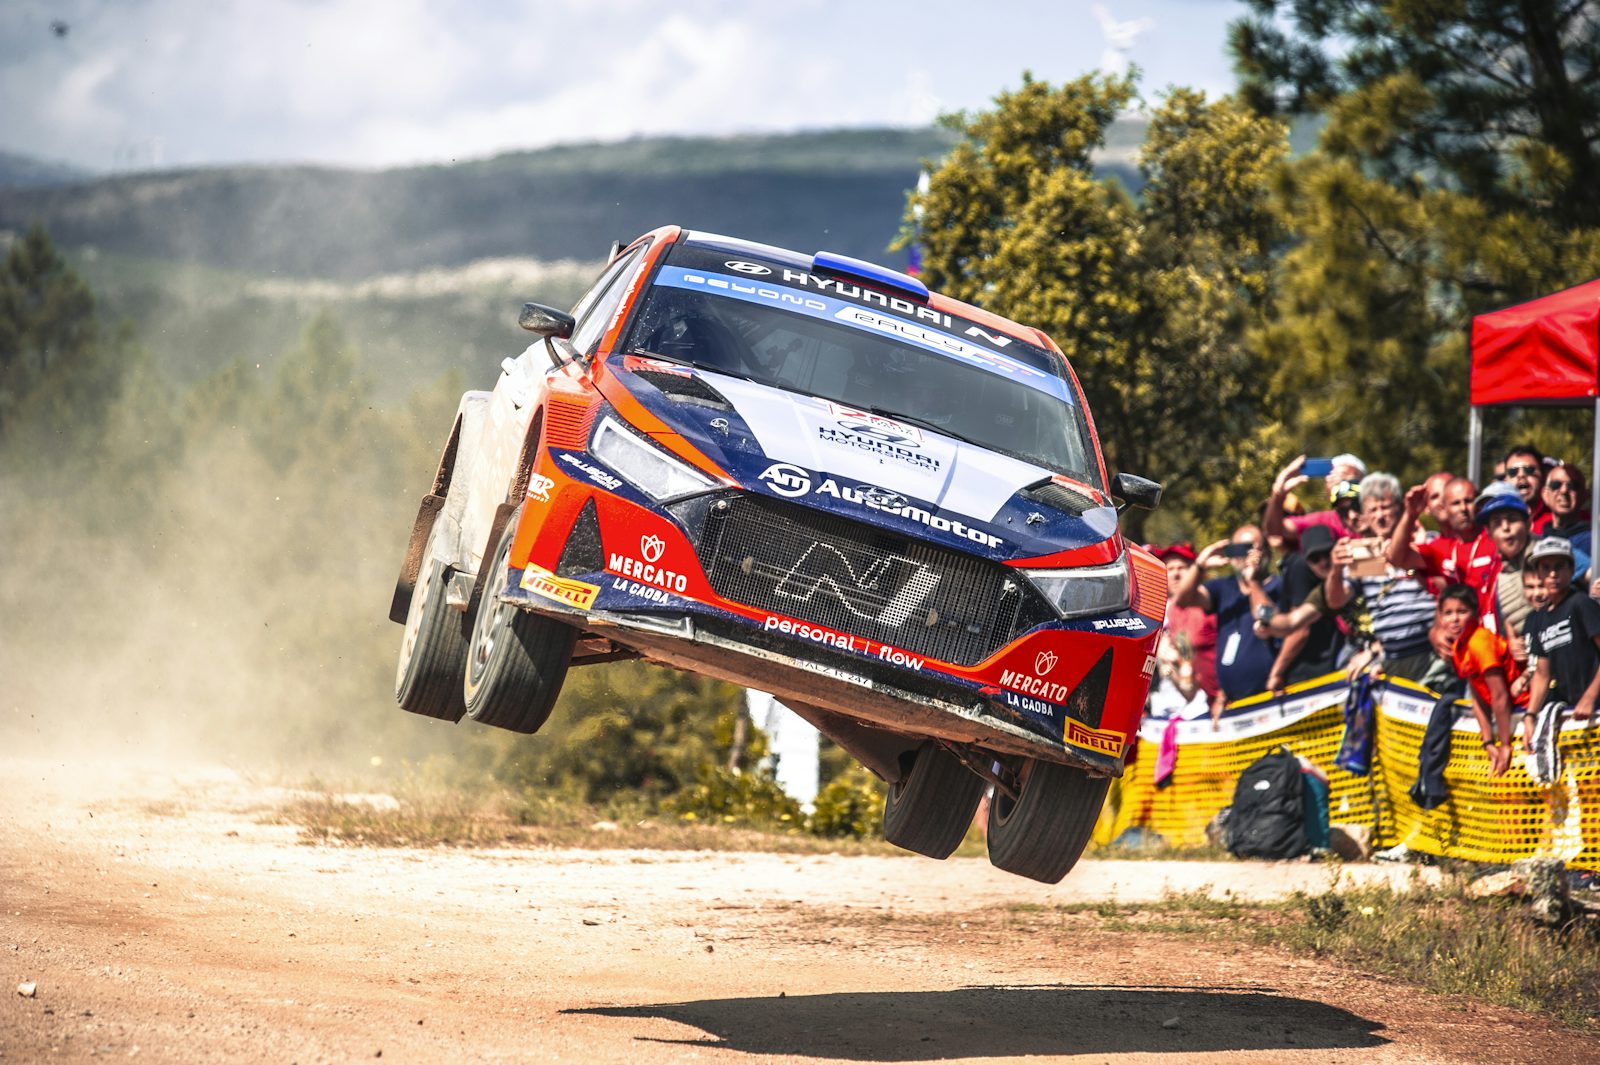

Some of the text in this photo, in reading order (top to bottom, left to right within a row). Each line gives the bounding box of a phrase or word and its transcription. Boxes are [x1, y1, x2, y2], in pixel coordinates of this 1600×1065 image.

[683, 274, 826, 311] BEYOND
[783, 269, 952, 328] HYUNDAI
[855, 313, 963, 352] RALLY
[819, 426, 940, 467] HYUNDAI
[820, 434, 940, 472] MOTORSPORT
[559, 453, 622, 489] PLUSCAR
[525, 569, 592, 605] PIRELLI
[609, 553, 687, 592] MERCATO
[612, 577, 669, 604] LA CAOBA
[1091, 617, 1144, 630] PLUSCAR
[764, 615, 924, 671] personal flow
[999, 669, 1068, 702] MERCATO
[1007, 692, 1054, 717] LA CAOBA
[1068, 722, 1122, 753] PIRELLI
